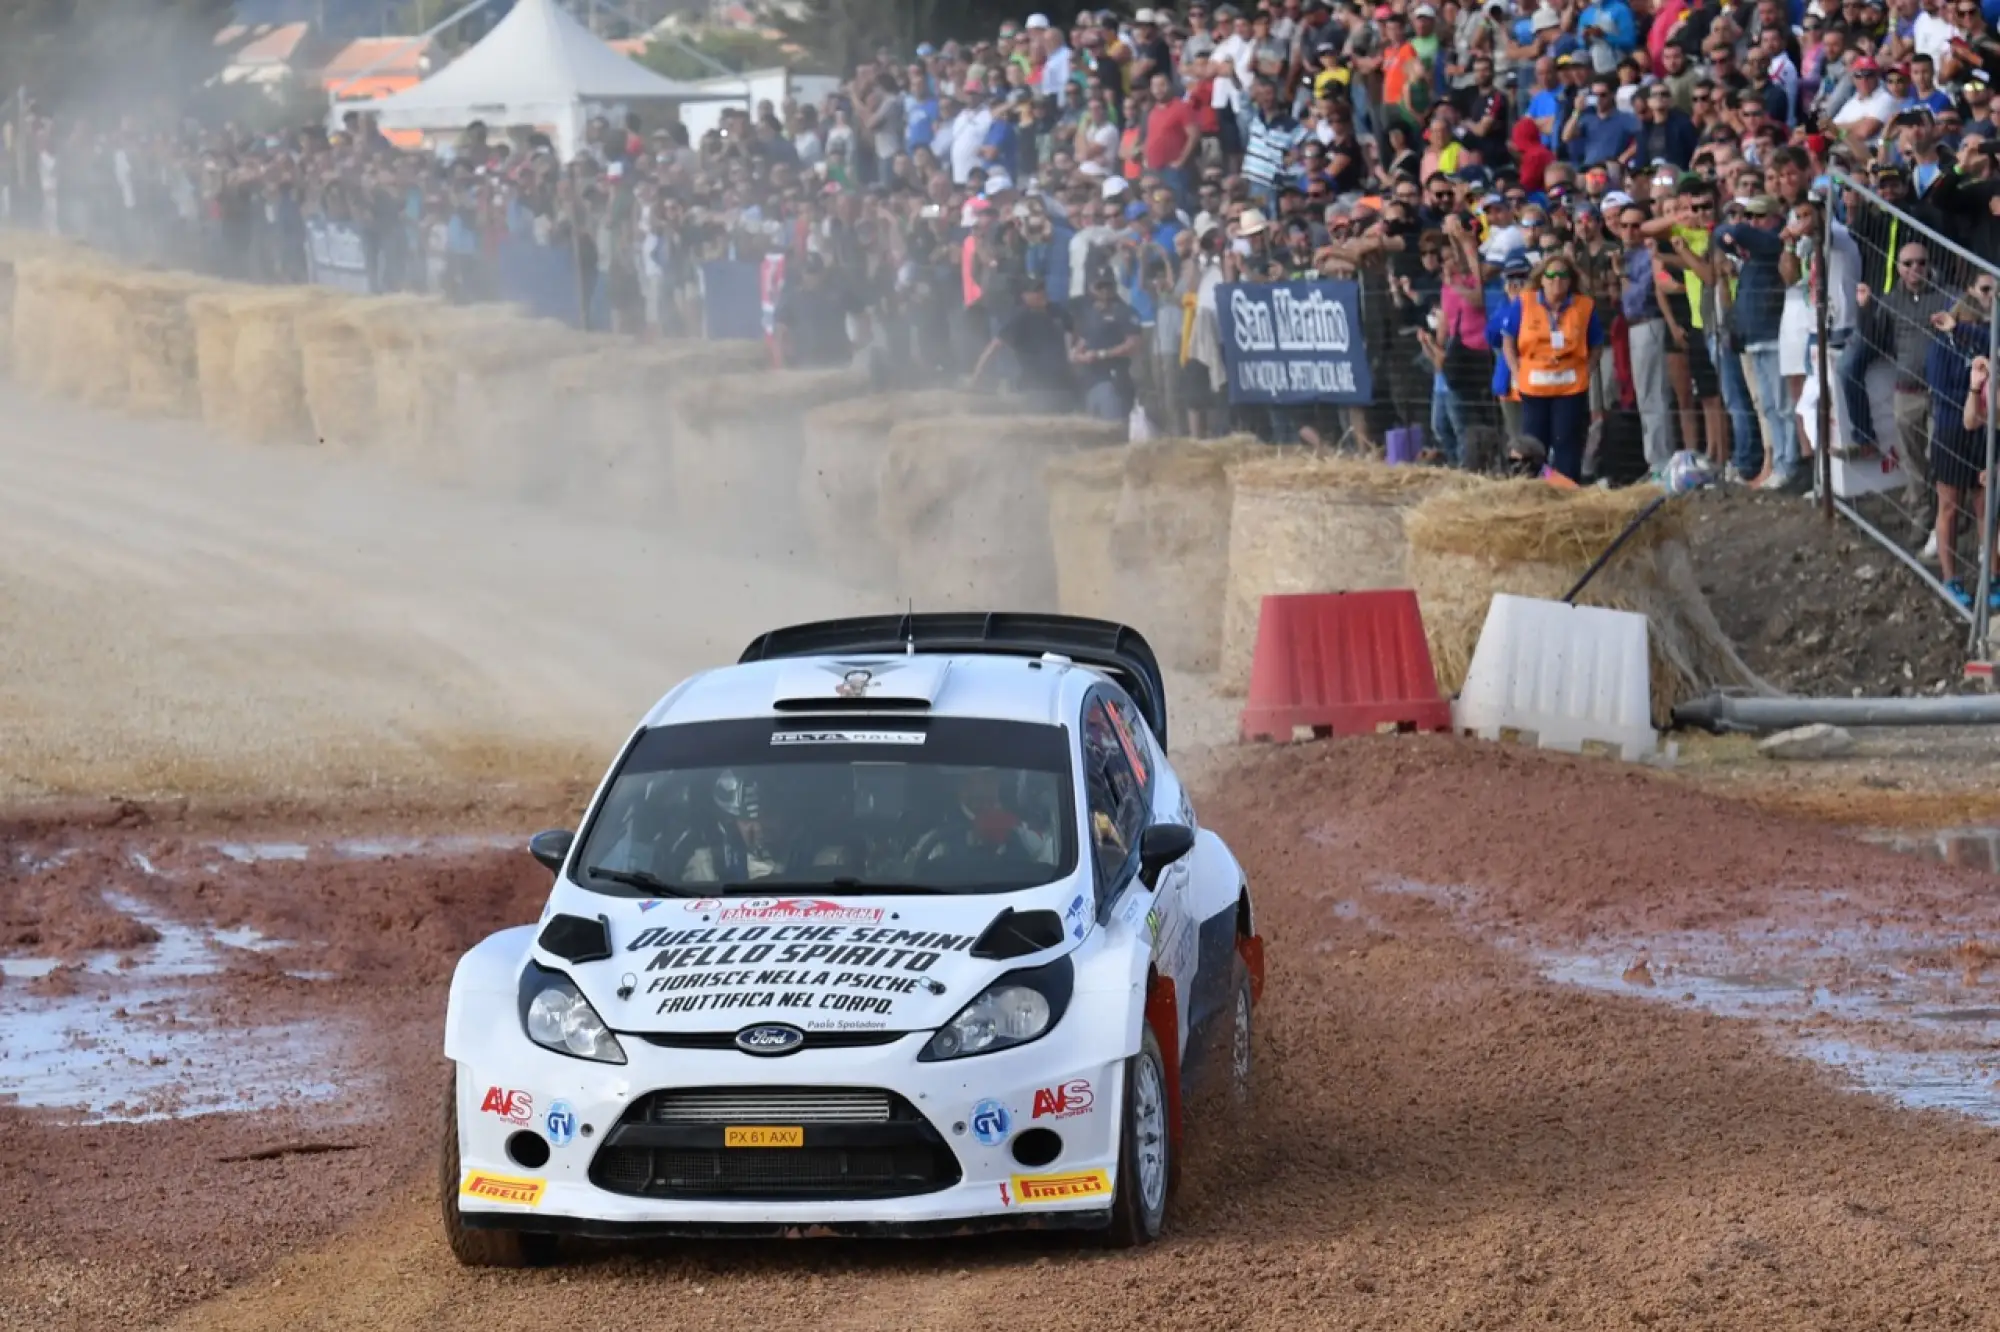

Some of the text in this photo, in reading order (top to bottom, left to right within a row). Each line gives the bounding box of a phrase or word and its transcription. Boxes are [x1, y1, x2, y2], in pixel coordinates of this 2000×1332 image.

[1231, 287, 1349, 352] San Martino
[626, 926, 771, 951] QUELLO
[770, 925, 846, 941] CHE
[645, 944, 942, 972] NELLO SPIRITO
[646, 970, 919, 994] FIORISCE NELLA PSICHE
[656, 991, 893, 1015] FRUTTIFICA NEL CORPO.
[807, 1018, 835, 1029] Paolo
[749, 1029, 788, 1045] Ford
[480, 1086, 533, 1121] AVS
[1032, 1079, 1095, 1119] AVS
[729, 1132, 748, 1142] PX
[770, 1132, 797, 1142] AXV
[468, 1176, 539, 1202] PIRELLI
[1020, 1175, 1102, 1199] PIRELLI
